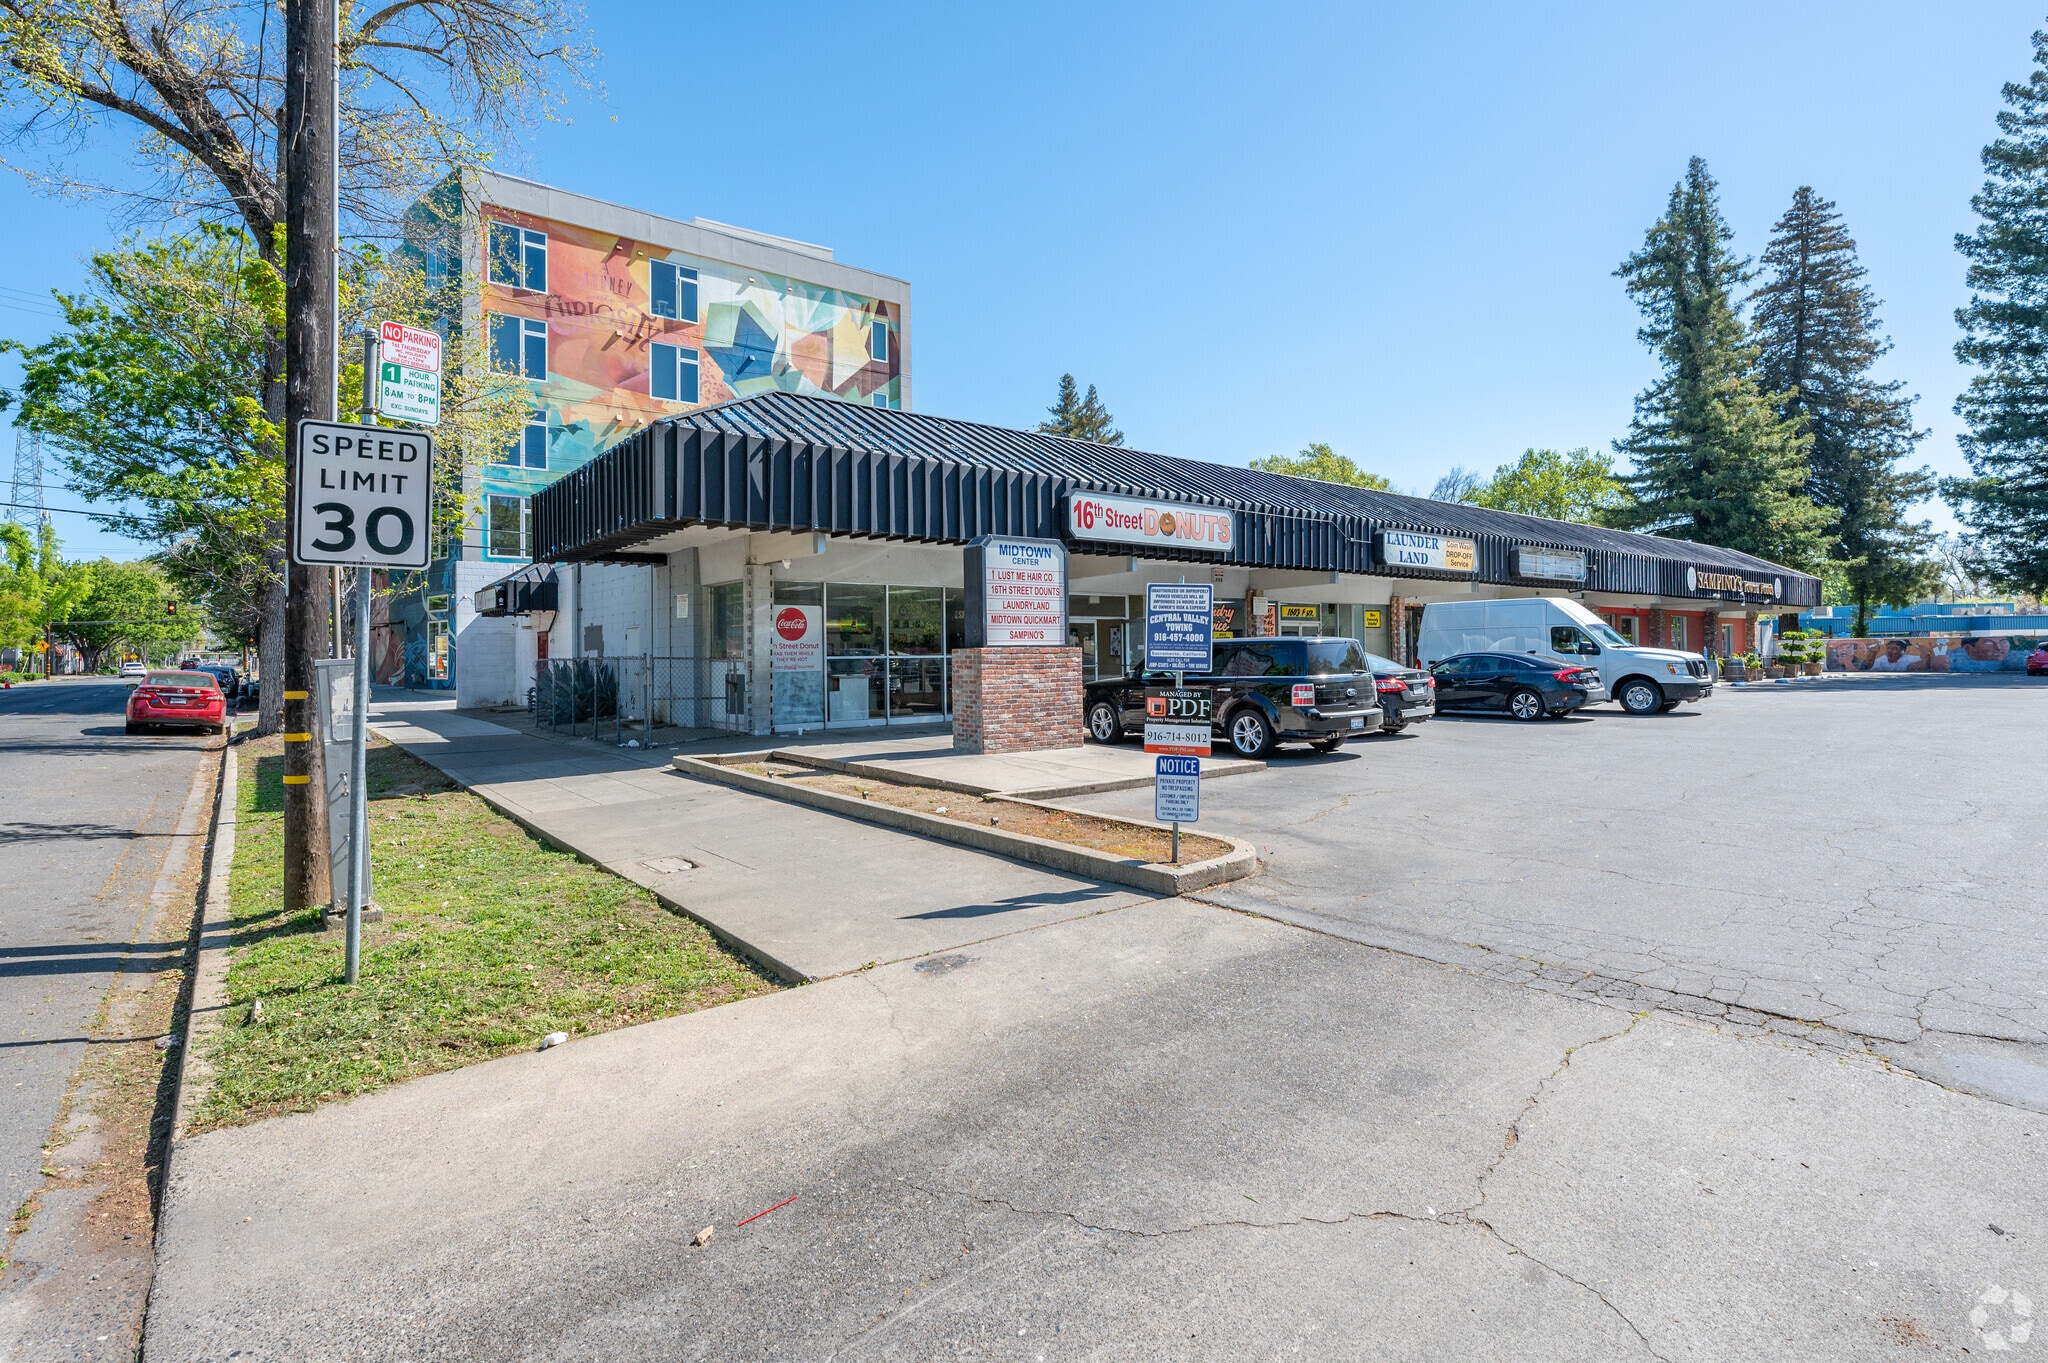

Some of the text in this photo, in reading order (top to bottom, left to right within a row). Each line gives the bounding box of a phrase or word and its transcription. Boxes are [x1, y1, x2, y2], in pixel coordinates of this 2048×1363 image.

[385, 325, 437, 349] NO PARKING
[401, 343, 431, 355] THURSDAY
[387, 366, 396, 381] 1
[408, 370, 430, 381] HOUR
[403, 378, 436, 392] PARKING
[404, 405, 429, 415] SUNDAYS
[312, 434, 418, 463] SPEED
[320, 468, 409, 495] LIMIT
[1073, 500, 1104, 530] 16th
[1105, 507, 1143, 531] Street
[311, 502, 415, 556] 30
[1386, 532, 1440, 550] LAUNDER
[1446, 540, 1473, 551] Coin Wash
[999, 544, 1052, 559] MIDTOWN
[1399, 550, 1429, 565] LAND
[1446, 550, 1473, 560] DROP-OFF
[1012, 557, 1040, 566] CENTER
[1450, 559, 1469, 568] Service
[998, 571, 1015, 580] LUST
[1016, 571, 1026, 581] ME
[1027, 573, 1042, 582] HAIR
[1043, 573, 1054, 582] CO.
[1697, 571, 1743, 592] SAMPINO'S
[991, 585, 1060, 596] 16TH STREET DOUNTS
[1002, 600, 1050, 611] LAUNDRYLAND
[1286, 607, 1301, 617] 1603
[777, 618, 805, 630] Coca-Cola
[991, 614, 1061, 625] MIDTOWN QUICKMART
[1150, 613, 1209, 625] CENTRAL VALLEY
[1165, 623, 1193, 632] TOWING
[1009, 630, 1045, 640] SAMPINO'S
[1154, 632, 1205, 642] 916-457-4000
[1168, 698, 1211, 717] PDF
[1147, 730, 1208, 743] 916-714-8012
[1160, 758, 1198, 774] NOTICE
